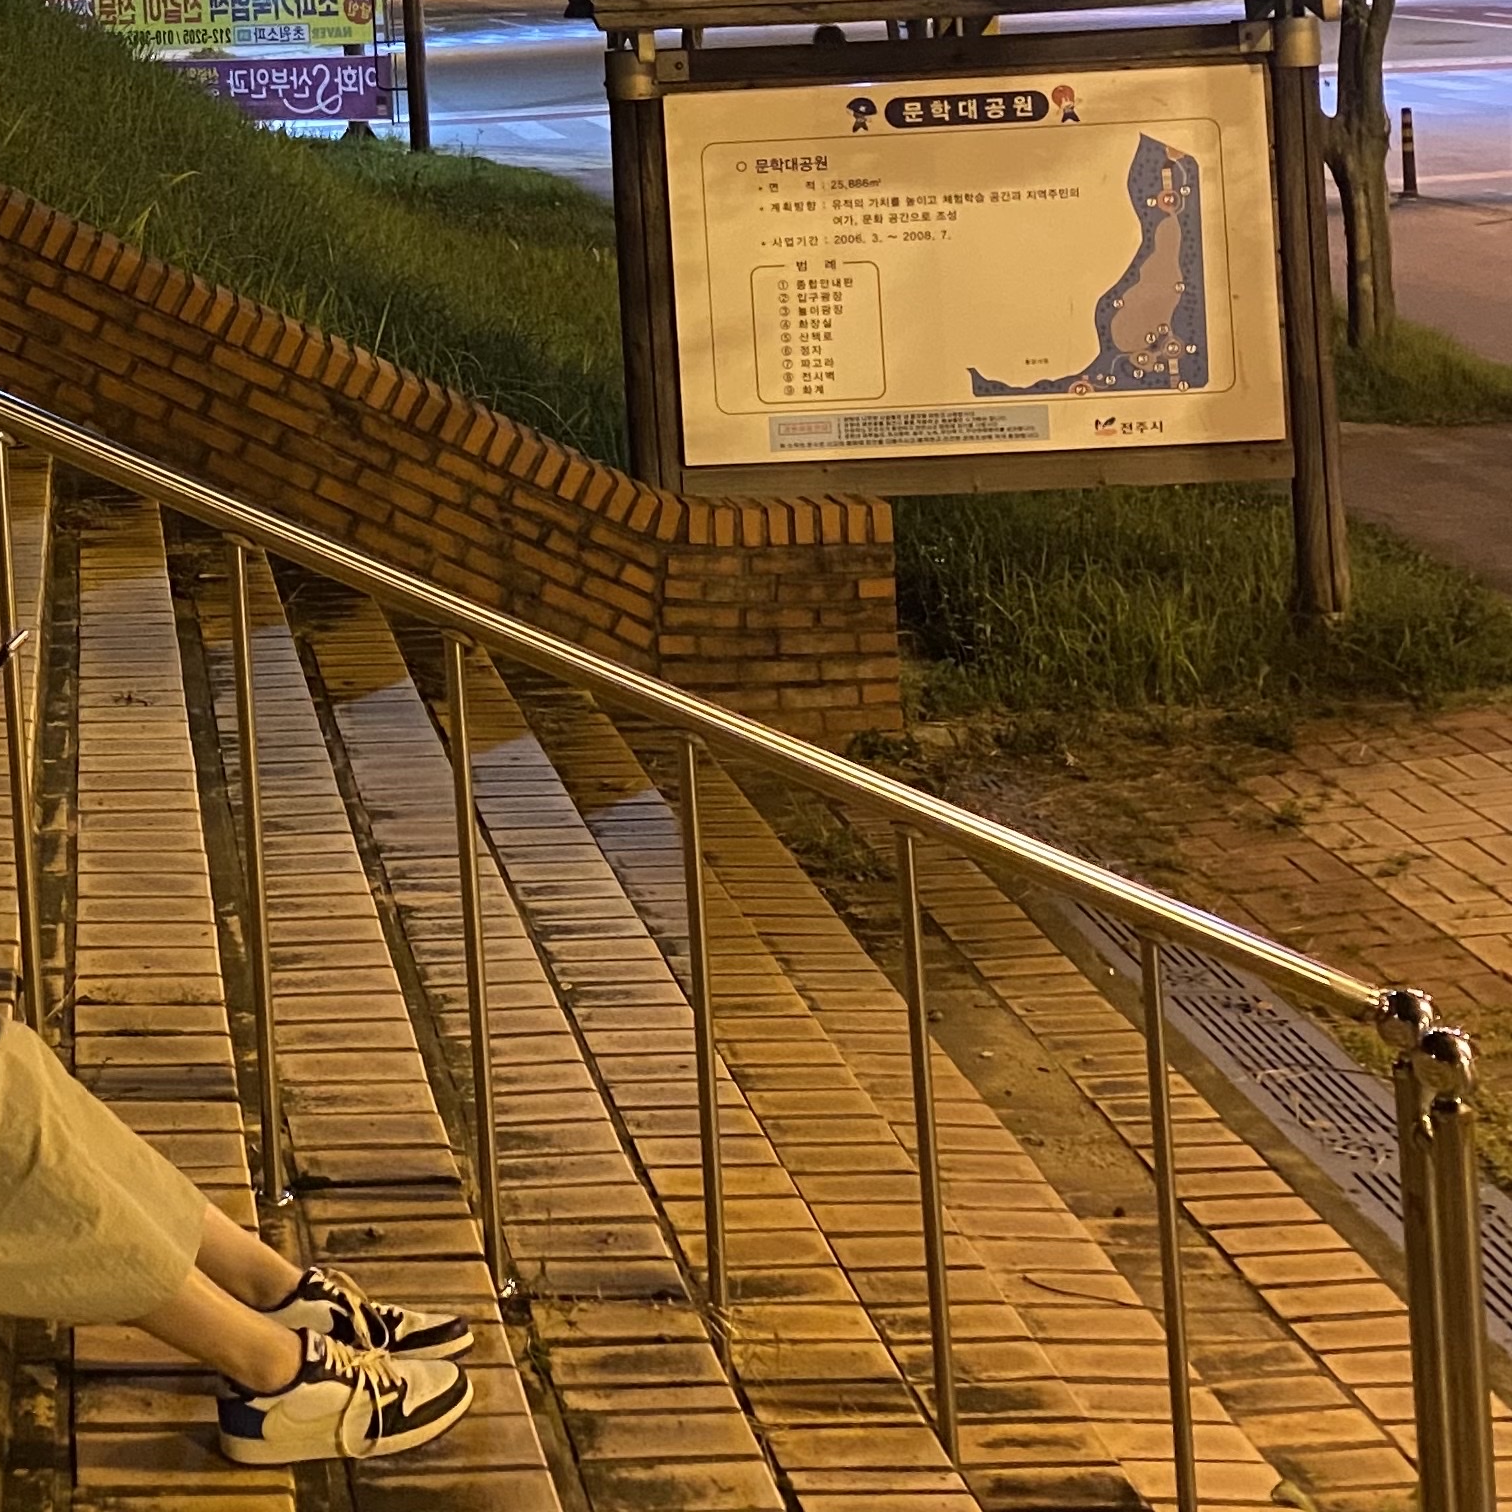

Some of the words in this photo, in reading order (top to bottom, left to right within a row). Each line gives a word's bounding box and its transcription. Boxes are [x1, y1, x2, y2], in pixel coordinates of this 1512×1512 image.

[902, 95, 1034, 123] 문학대공원
[755, 155, 828, 174] 문학대공원
[862, 213, 884, 225] 문화
[888, 211, 932, 224] 공간으로
[935, 210, 958, 222] 조성
[772, 236, 819, 248] 사업기간
[797, 291, 843, 303] 입구광장
[798, 318, 832, 329] 화장실
[800, 345, 822, 356] 정자
[1120, 420, 1163, 435] 전주시
